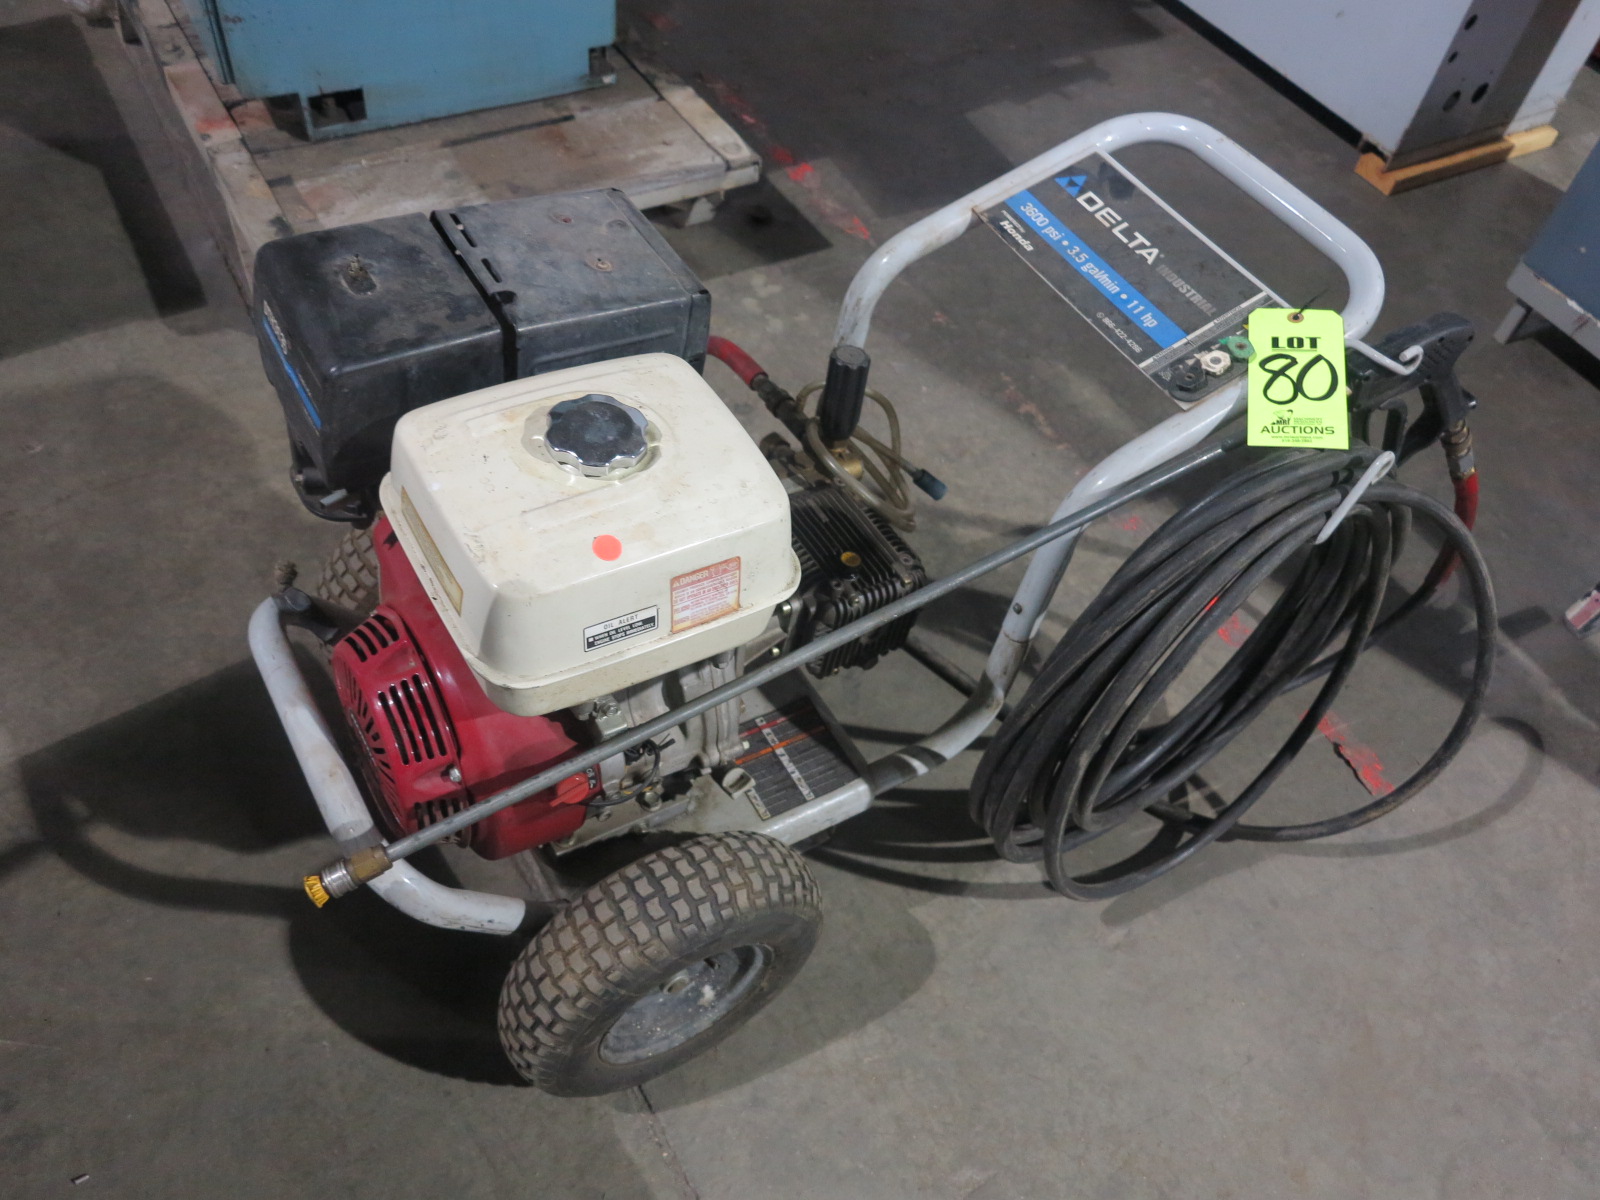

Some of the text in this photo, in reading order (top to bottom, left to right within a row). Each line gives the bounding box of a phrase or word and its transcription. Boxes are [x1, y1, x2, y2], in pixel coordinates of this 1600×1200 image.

[999, 220, 1034, 251] Honda
[1020, 202, 1050, 227] 3600
[1041, 226, 1065, 241] psi
[1066, 245, 1089, 263] 3.5
[1126, 300, 1146, 315] 11
[1141, 312, 1159, 328] hp
[1076, 191, 1217, 317] DELTA INDUSTRIAL
[1271, 336, 1321, 349] LOT
[1259, 353, 1338, 405] 80
[1260, 425, 1335, 435] AUCTIONS
[681, 570, 709, 585] DANGER
[603, 614, 639, 630] OIL ALERT
